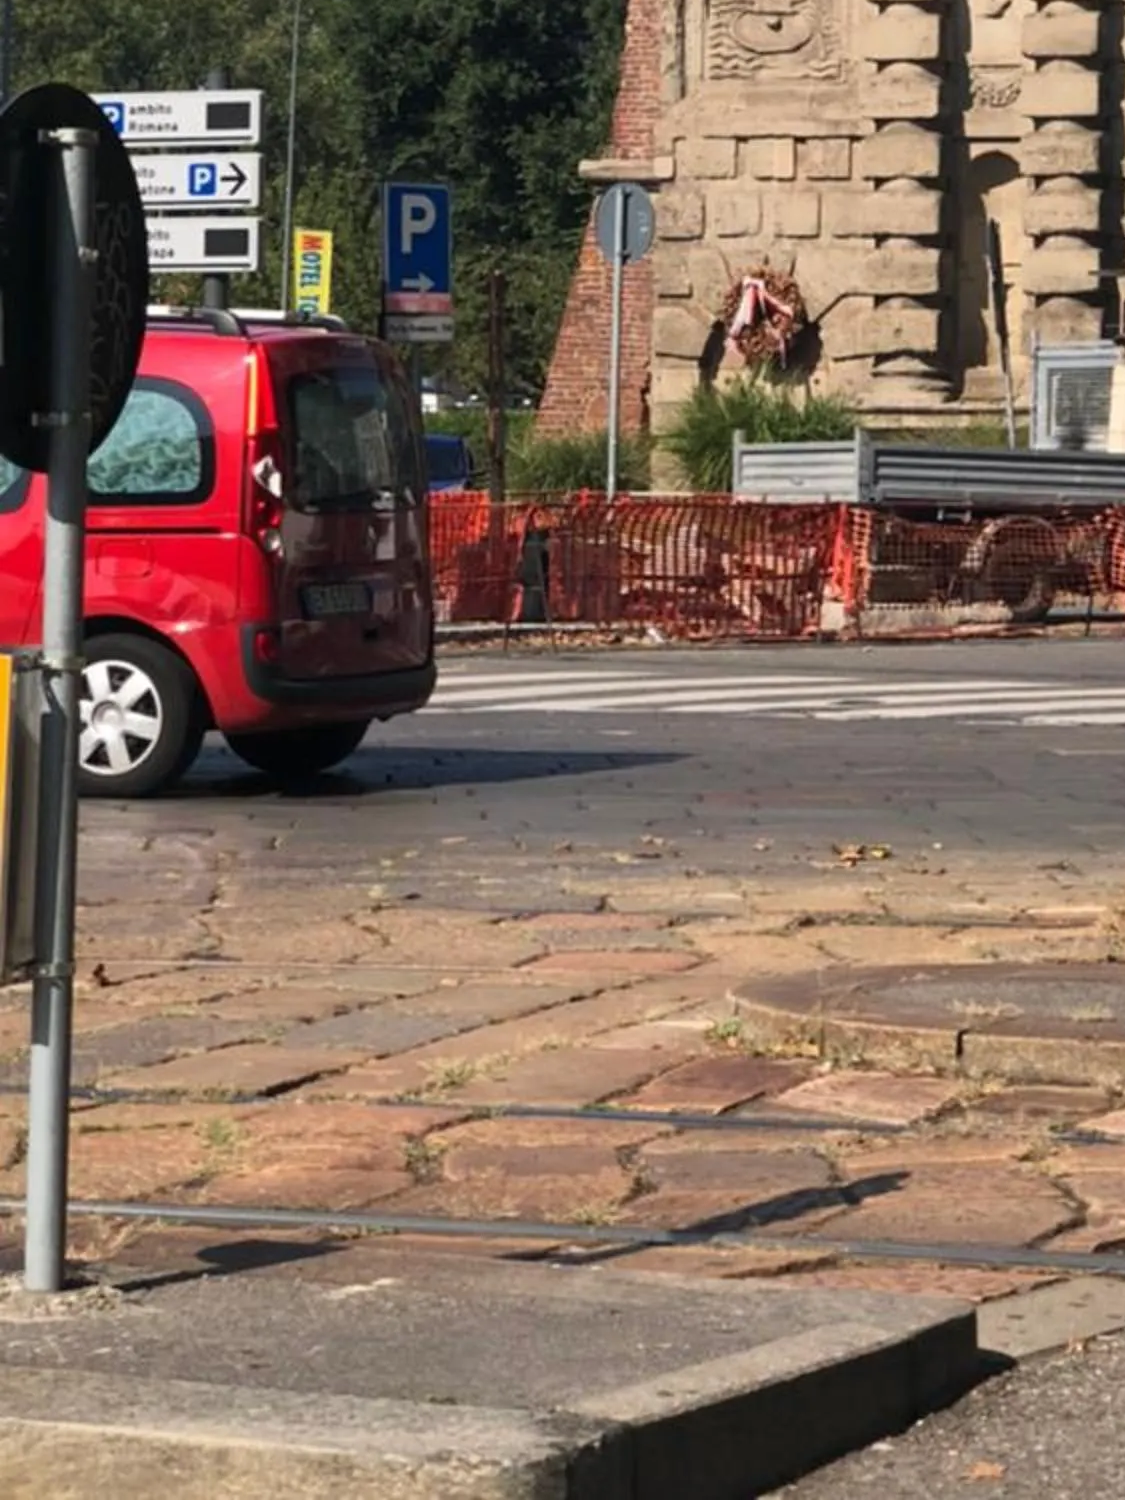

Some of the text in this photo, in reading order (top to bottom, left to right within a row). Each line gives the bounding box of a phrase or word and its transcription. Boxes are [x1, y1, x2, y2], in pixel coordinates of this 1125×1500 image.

[129, 103, 172, 115] ambito
[129, 121, 178, 132] Romana
[194, 168, 211, 192] P
[401, 193, 437, 254] P
[300, 235, 324, 288] MOTEL
